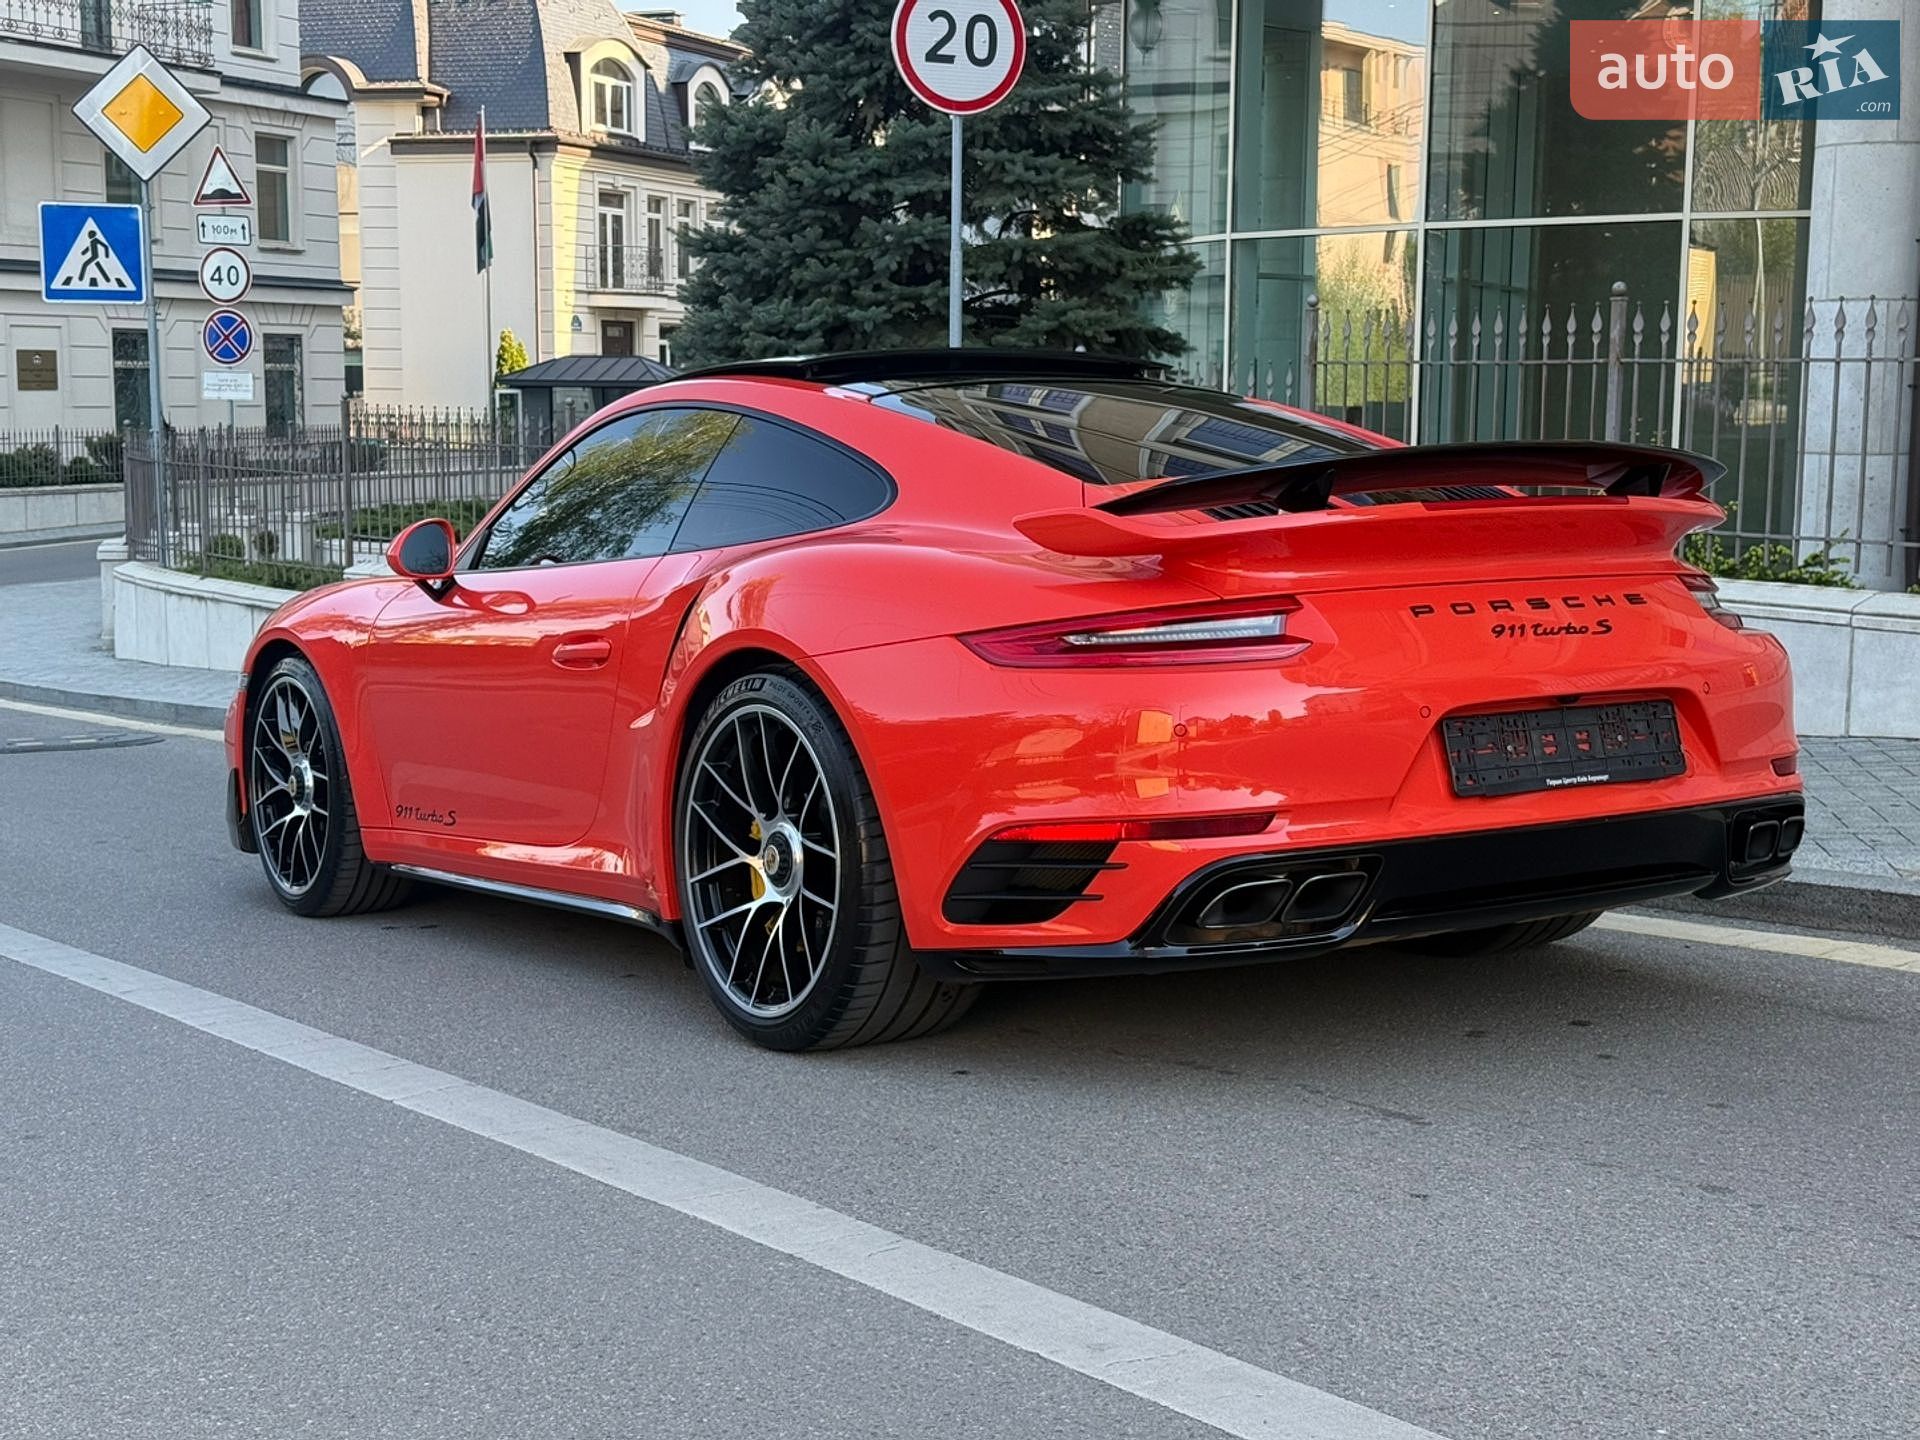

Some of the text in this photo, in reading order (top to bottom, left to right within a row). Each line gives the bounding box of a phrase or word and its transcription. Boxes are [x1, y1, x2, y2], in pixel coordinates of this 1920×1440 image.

[925, 9, 998, 67] 20
[210, 265, 240, 286] 40
[1409, 593, 1648, 618] PORSCHE
[1491, 619, 1613, 639] 911 turbo S
[396, 804, 457, 826] 911 turbo S
